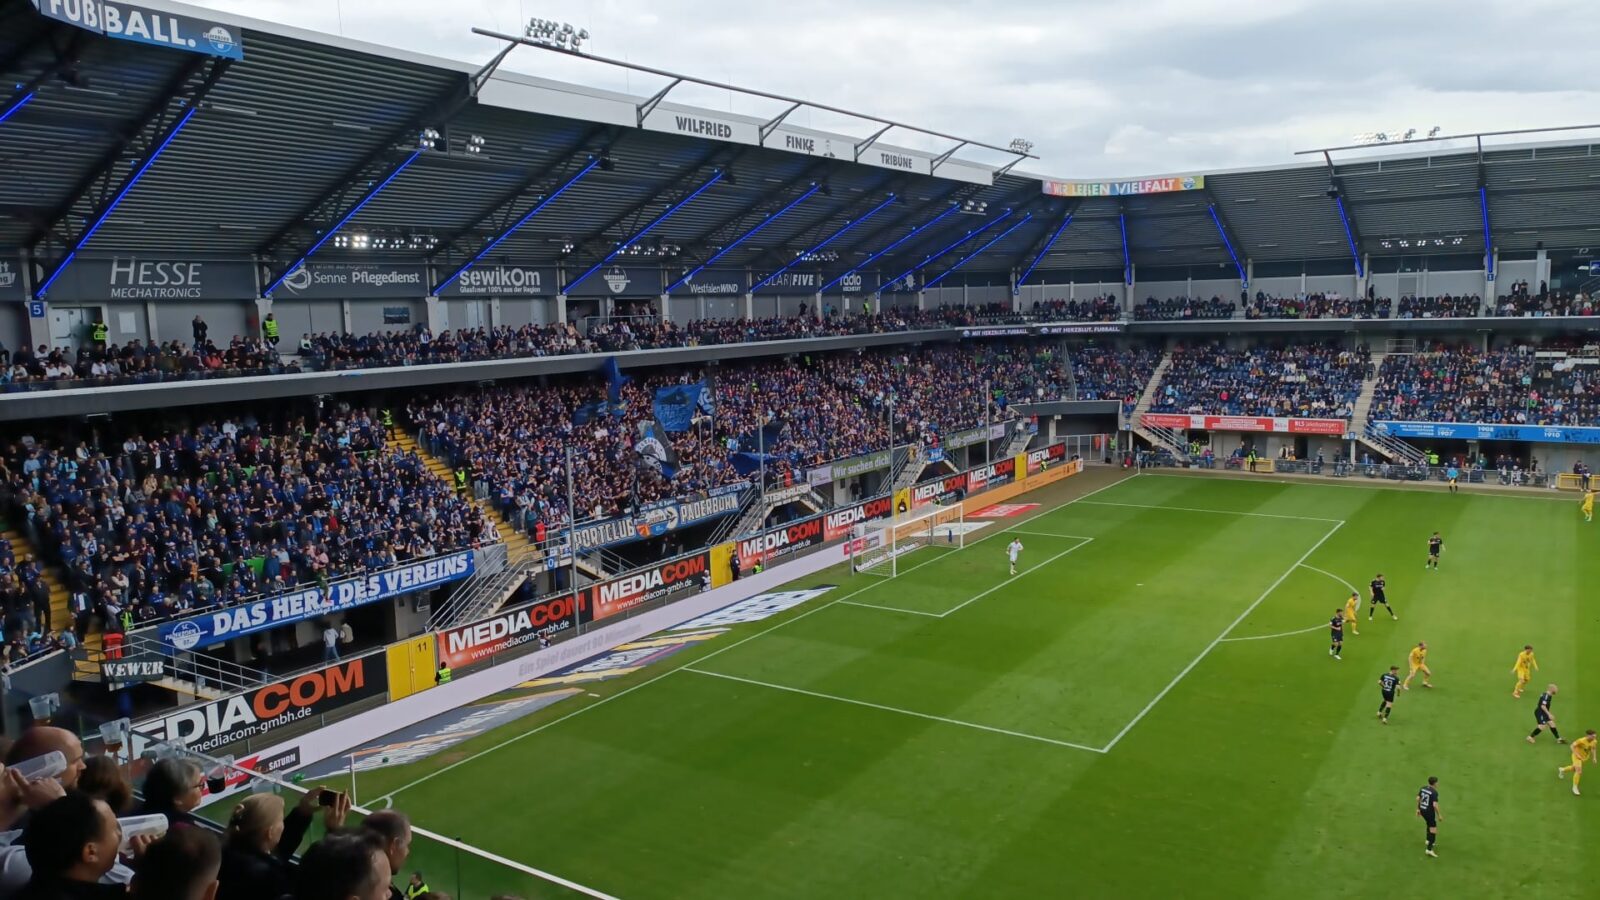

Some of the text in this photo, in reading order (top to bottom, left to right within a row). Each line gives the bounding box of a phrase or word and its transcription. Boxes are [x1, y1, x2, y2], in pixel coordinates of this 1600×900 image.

[676, 115, 732, 138] WILFRIED
[786, 135, 814, 151] FINKE
[881, 153, 912, 169] TRIBÜNE
[1115, 179, 1175, 195] VIELFALT
[110, 256, 202, 285] HESSE
[314, 271, 420, 286] Senne Pflegedienst
[459, 267, 541, 286] sewikOm
[111, 288, 201, 298] MECHATRONICS
[690, 283, 738, 294] WestfalenWIND
[33, 305, 41, 315] 5
[833, 466, 846, 478] Wir
[848, 461, 873, 475] suchen
[914, 474, 965, 502] MEDIACOM
[681, 495, 738, 523] PADERBORN
[828, 497, 891, 530] MEDIACOM
[742, 519, 820, 558] MEDIACOM
[600, 555, 704, 604] MEDIACOM
[213, 607, 267, 637] DAS
[339, 574, 381, 606] DES
[384, 553, 468, 593] VEREINS
[448, 592, 585, 654] MEDIACOM
[416, 642, 427, 653] 11
[103, 661, 164, 679] WEWER
[268, 753, 296, 771] SATURN
